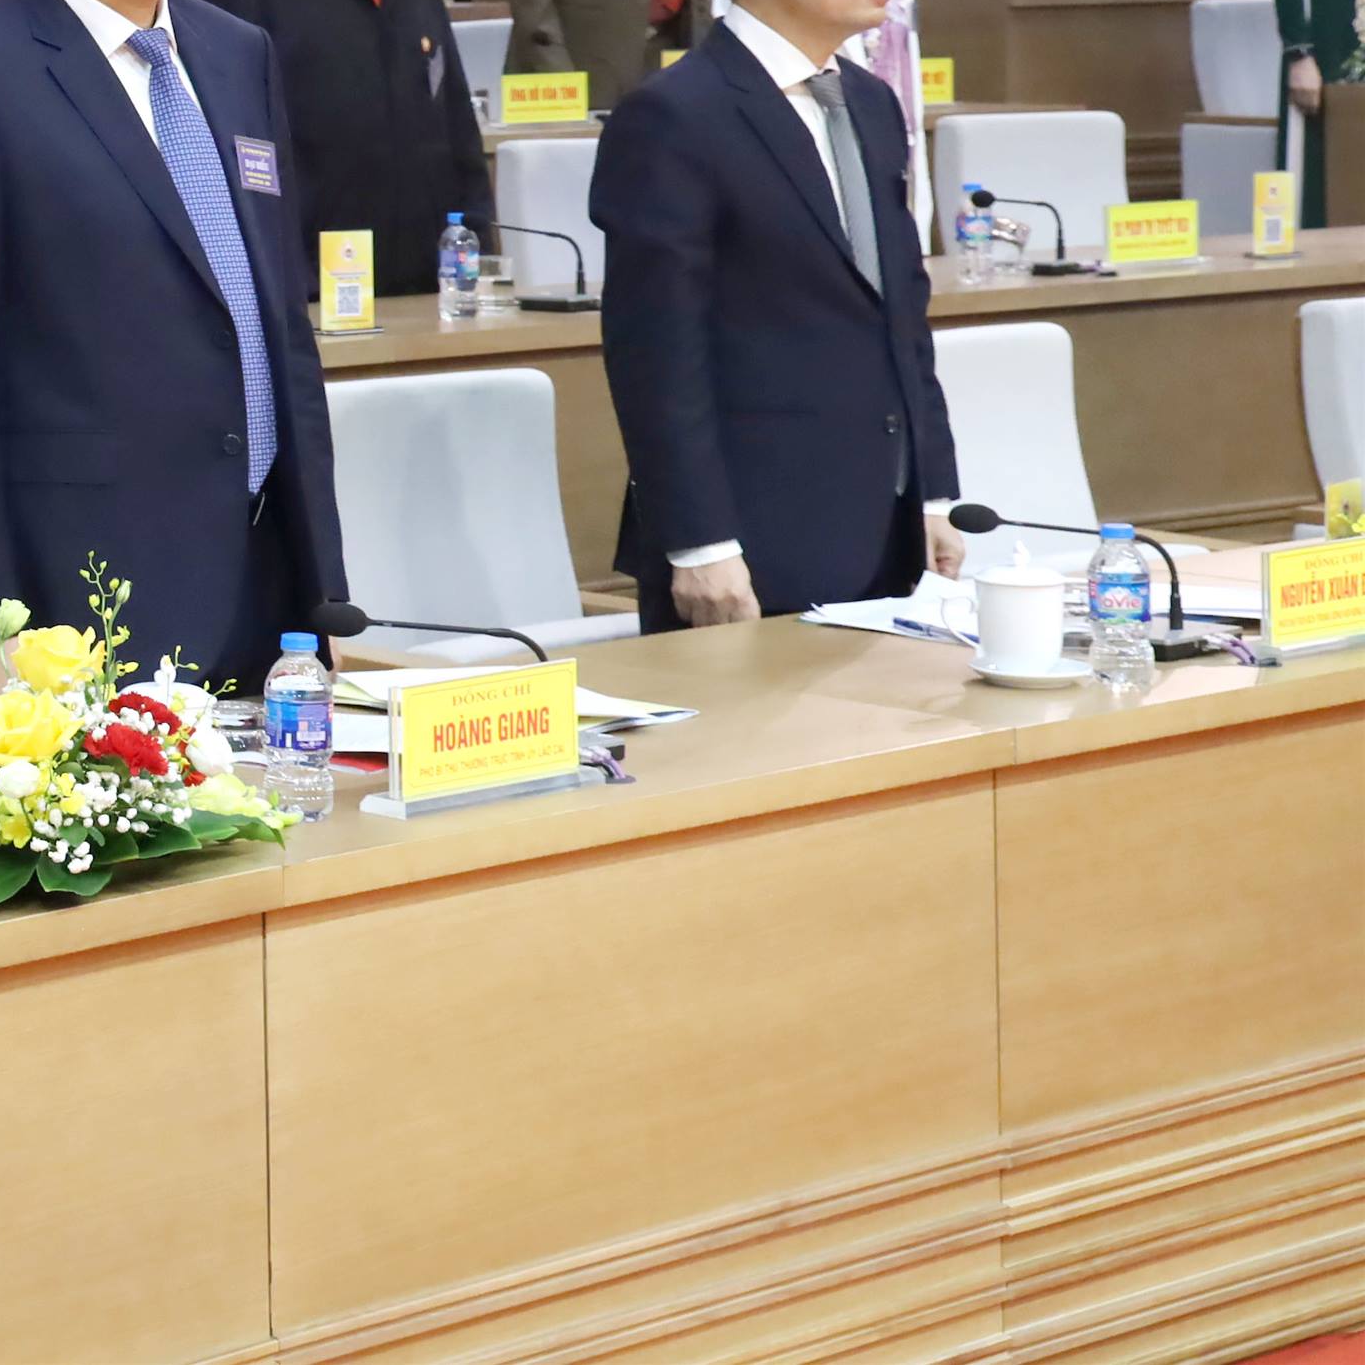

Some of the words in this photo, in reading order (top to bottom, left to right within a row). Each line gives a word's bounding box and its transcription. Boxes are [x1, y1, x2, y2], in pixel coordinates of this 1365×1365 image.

[1281, 571, 1325, 609] NGUYỄN
[452, 689, 497, 706] ĐỒNG
[503, 682, 531, 697] CHÍ
[434, 714, 491, 753] HOÀNG
[498, 707, 549, 741] GIANG
